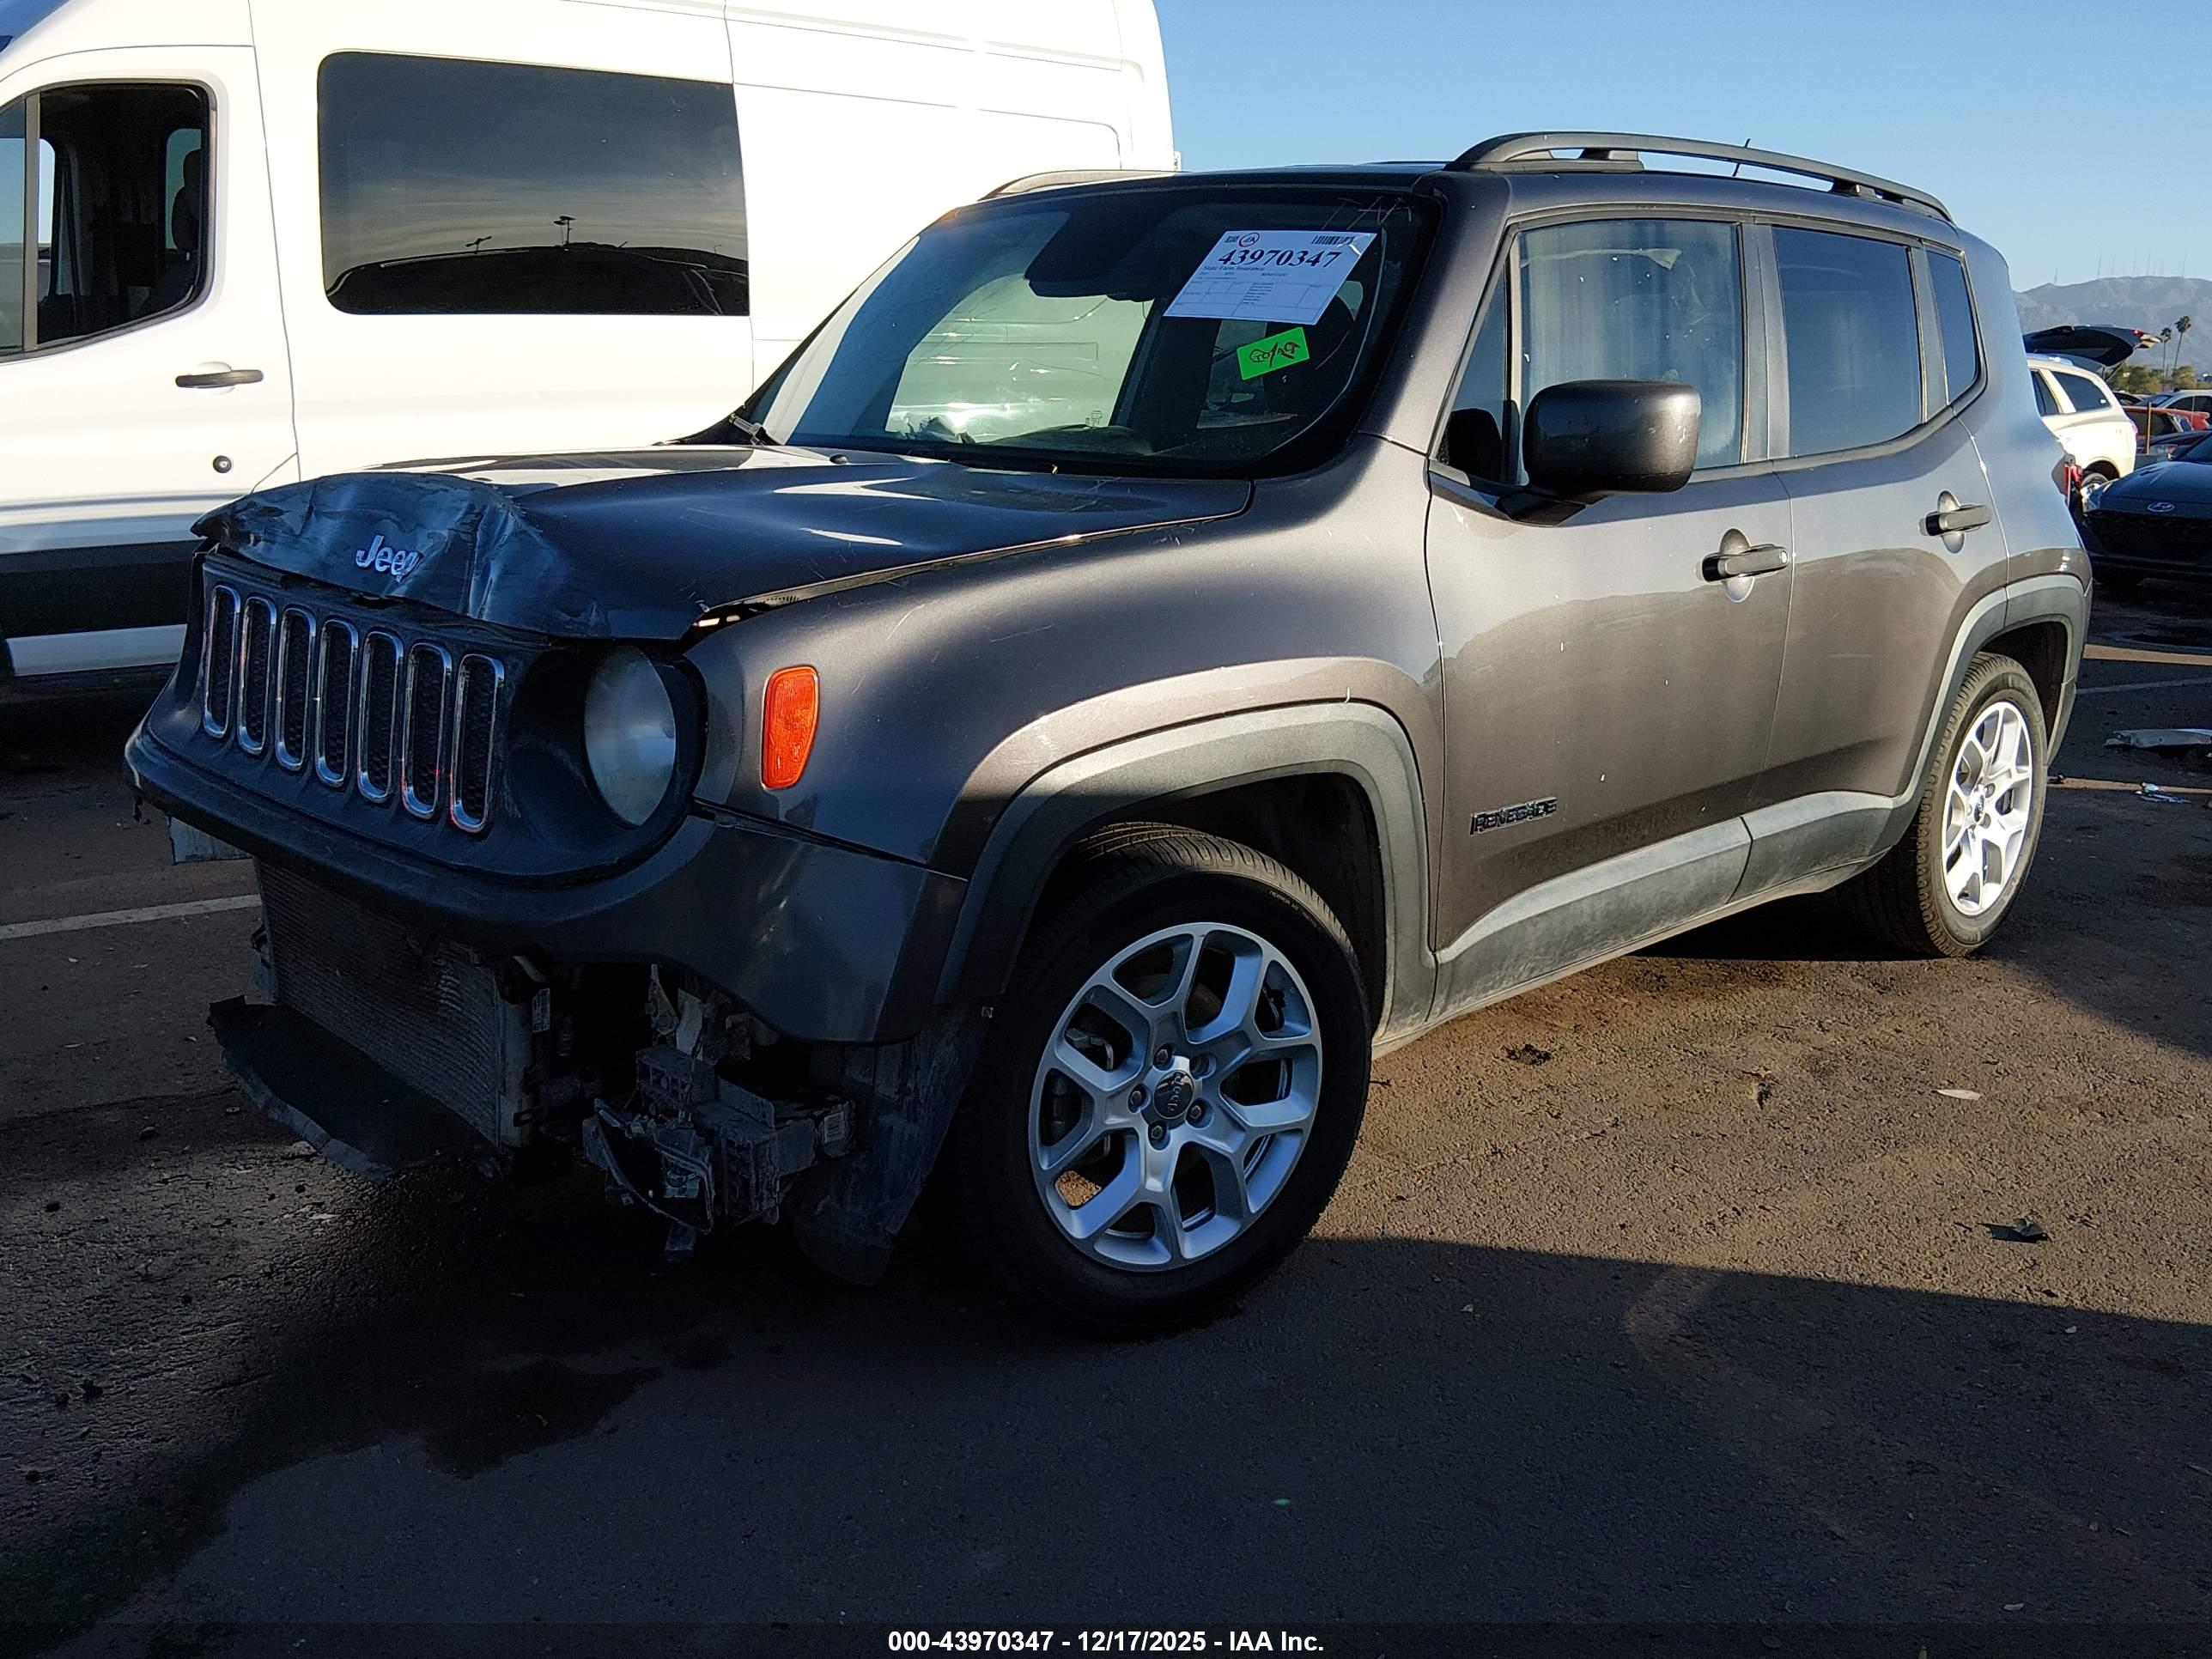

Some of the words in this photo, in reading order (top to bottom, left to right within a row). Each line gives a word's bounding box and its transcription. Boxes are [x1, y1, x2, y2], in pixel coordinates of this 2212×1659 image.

[1218, 249, 1343, 268] 43970347
[356, 535, 422, 583] Jeep
[1469, 796, 1558, 836] RENEGADE
